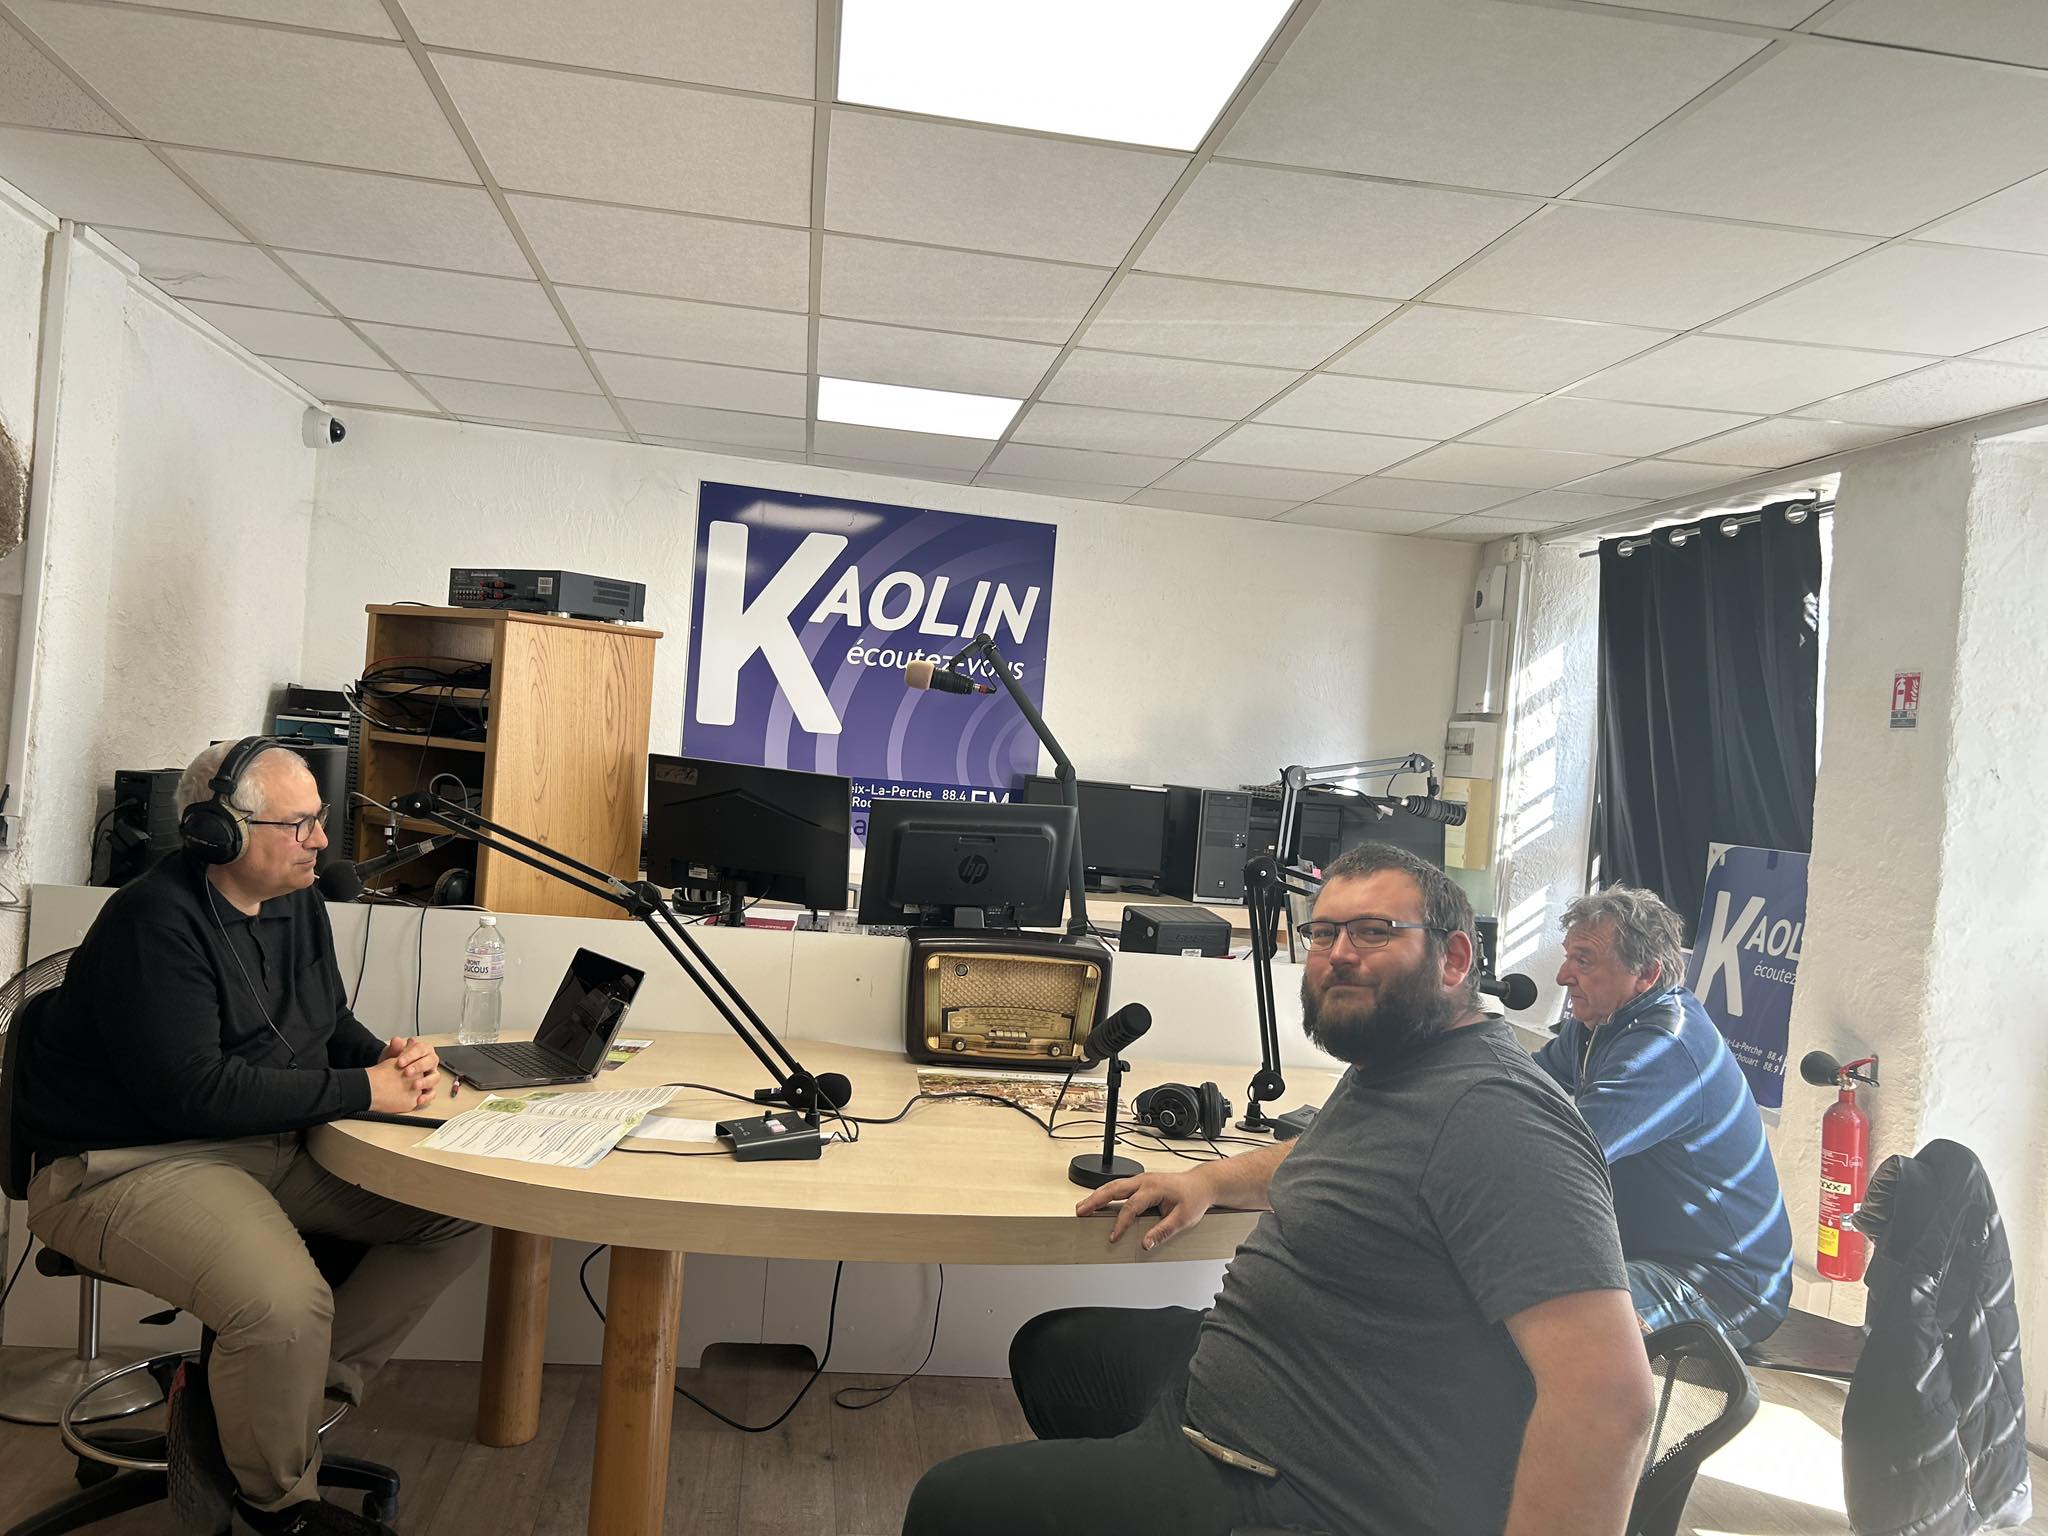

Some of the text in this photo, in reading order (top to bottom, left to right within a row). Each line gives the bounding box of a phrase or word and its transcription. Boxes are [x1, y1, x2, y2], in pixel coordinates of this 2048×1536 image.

[696, 520, 1041, 735] KAOLIN
[846, 638, 1025, 681] écoutez-vos
[942, 789, 966, 801] 88.4
[962, 856, 986, 884] hp
